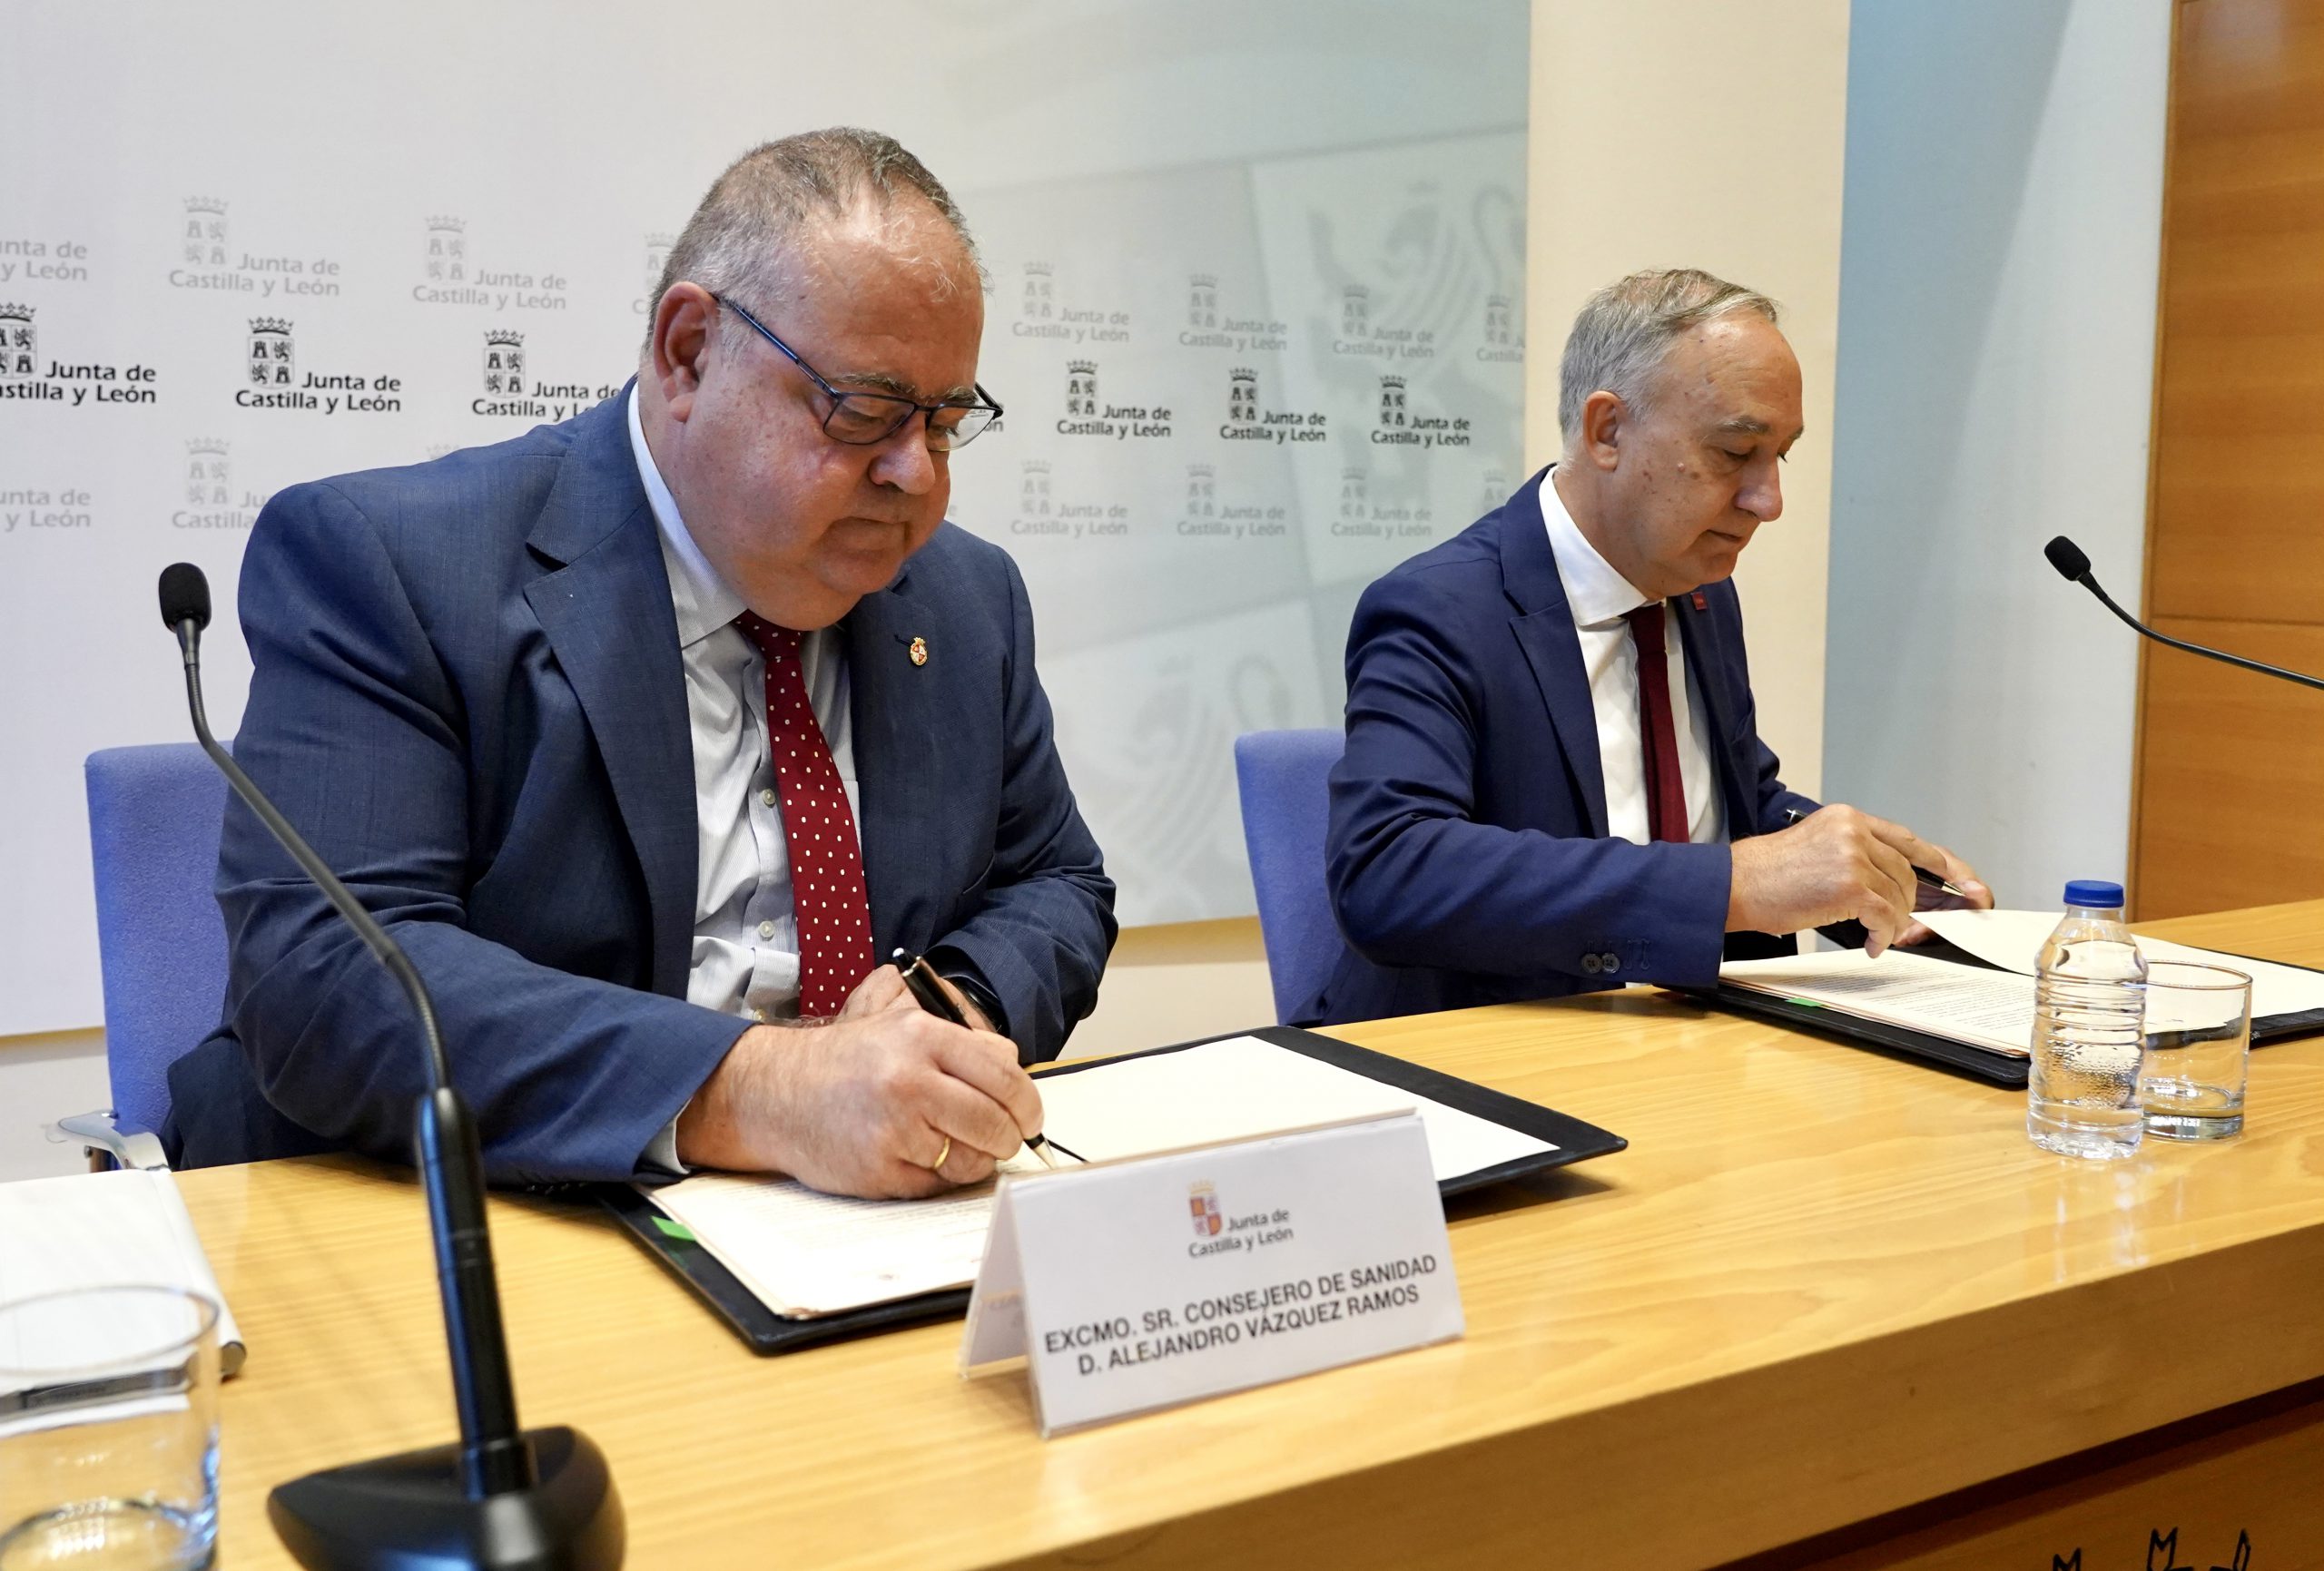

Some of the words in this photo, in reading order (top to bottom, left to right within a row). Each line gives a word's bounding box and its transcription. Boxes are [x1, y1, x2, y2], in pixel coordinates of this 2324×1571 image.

[56, 241, 87, 260] de
[1, 263, 15, 282] y
[25, 260, 87, 281] León
[237, 253, 304, 273] Junta
[311, 260, 340, 276] de
[169, 270, 254, 291] Castilla
[262, 279, 275, 298] y
[284, 277, 340, 296] León
[474, 270, 534, 289] Junta
[541, 274, 566, 290] de
[412, 285, 489, 306] Castilla
[497, 294, 508, 311] y
[517, 291, 566, 310] León
[1058, 308, 1105, 324] Junta
[1109, 309, 1129, 326] de
[1221, 318, 1264, 333] Junta
[1269, 319, 1287, 335] de
[1012, 321, 1071, 339] Castilla
[1075, 327, 1087, 344] y
[1090, 324, 1129, 342] León
[1179, 331, 1233, 348] Castilla
[1236, 337, 1246, 353] y
[45, 361, 116, 381] Junta
[126, 365, 157, 383] de
[301, 372, 365, 391] Junta
[374, 376, 401, 392] de
[0, 382, 64, 400] stilla
[73, 388, 87, 407] y
[96, 385, 156, 404] León
[532, 382, 589, 399] Junta
[236, 389, 318, 409] Castilla
[325, 397, 339, 416] y
[348, 394, 401, 412] León
[472, 398, 546, 417] Castilla
[553, 406, 566, 423] y
[1102, 405, 1147, 420] Junta
[1152, 407, 1172, 421] de
[1057, 419, 1113, 437] Castilla
[1118, 425, 1128, 440] y
[1133, 422, 1171, 437] León
[1263, 411, 1304, 426] Junta
[1307, 413, 1326, 427] de
[1411, 417, 1449, 430] Junta
[1453, 417, 1471, 431] de
[1220, 425, 1272, 441] Castilla
[1276, 430, 1287, 445] y
[1290, 427, 1326, 443] León
[1371, 430, 1421, 446] Castilla
[1424, 437, 1434, 450] y
[1437, 434, 1470, 447] León
[60, 489, 91, 506] de
[5, 512, 20, 533] y
[30, 508, 91, 527] León
[1227, 1214, 1268, 1232] Junta
[1272, 1208, 1289, 1223] de
[1188, 1236, 1242, 1258] Castilla
[1245, 1235, 1254, 1252] y
[1257, 1226, 1294, 1245] León
[1045, 1318, 1137, 1353] EXCMO.
[1142, 1309, 1179, 1332] SR.
[1184, 1280, 1313, 1323] CONSEJERO
[1318, 1272, 1345, 1295] DE
[1350, 1254, 1437, 1289] SANIDAD
[1078, 1354, 1102, 1376] D.
[1108, 1322, 1241, 1369] ALEJANDRO
[1245, 1301, 1343, 1339] VÁZQUEZ
[1347, 1283, 1419, 1316] RAMOS
